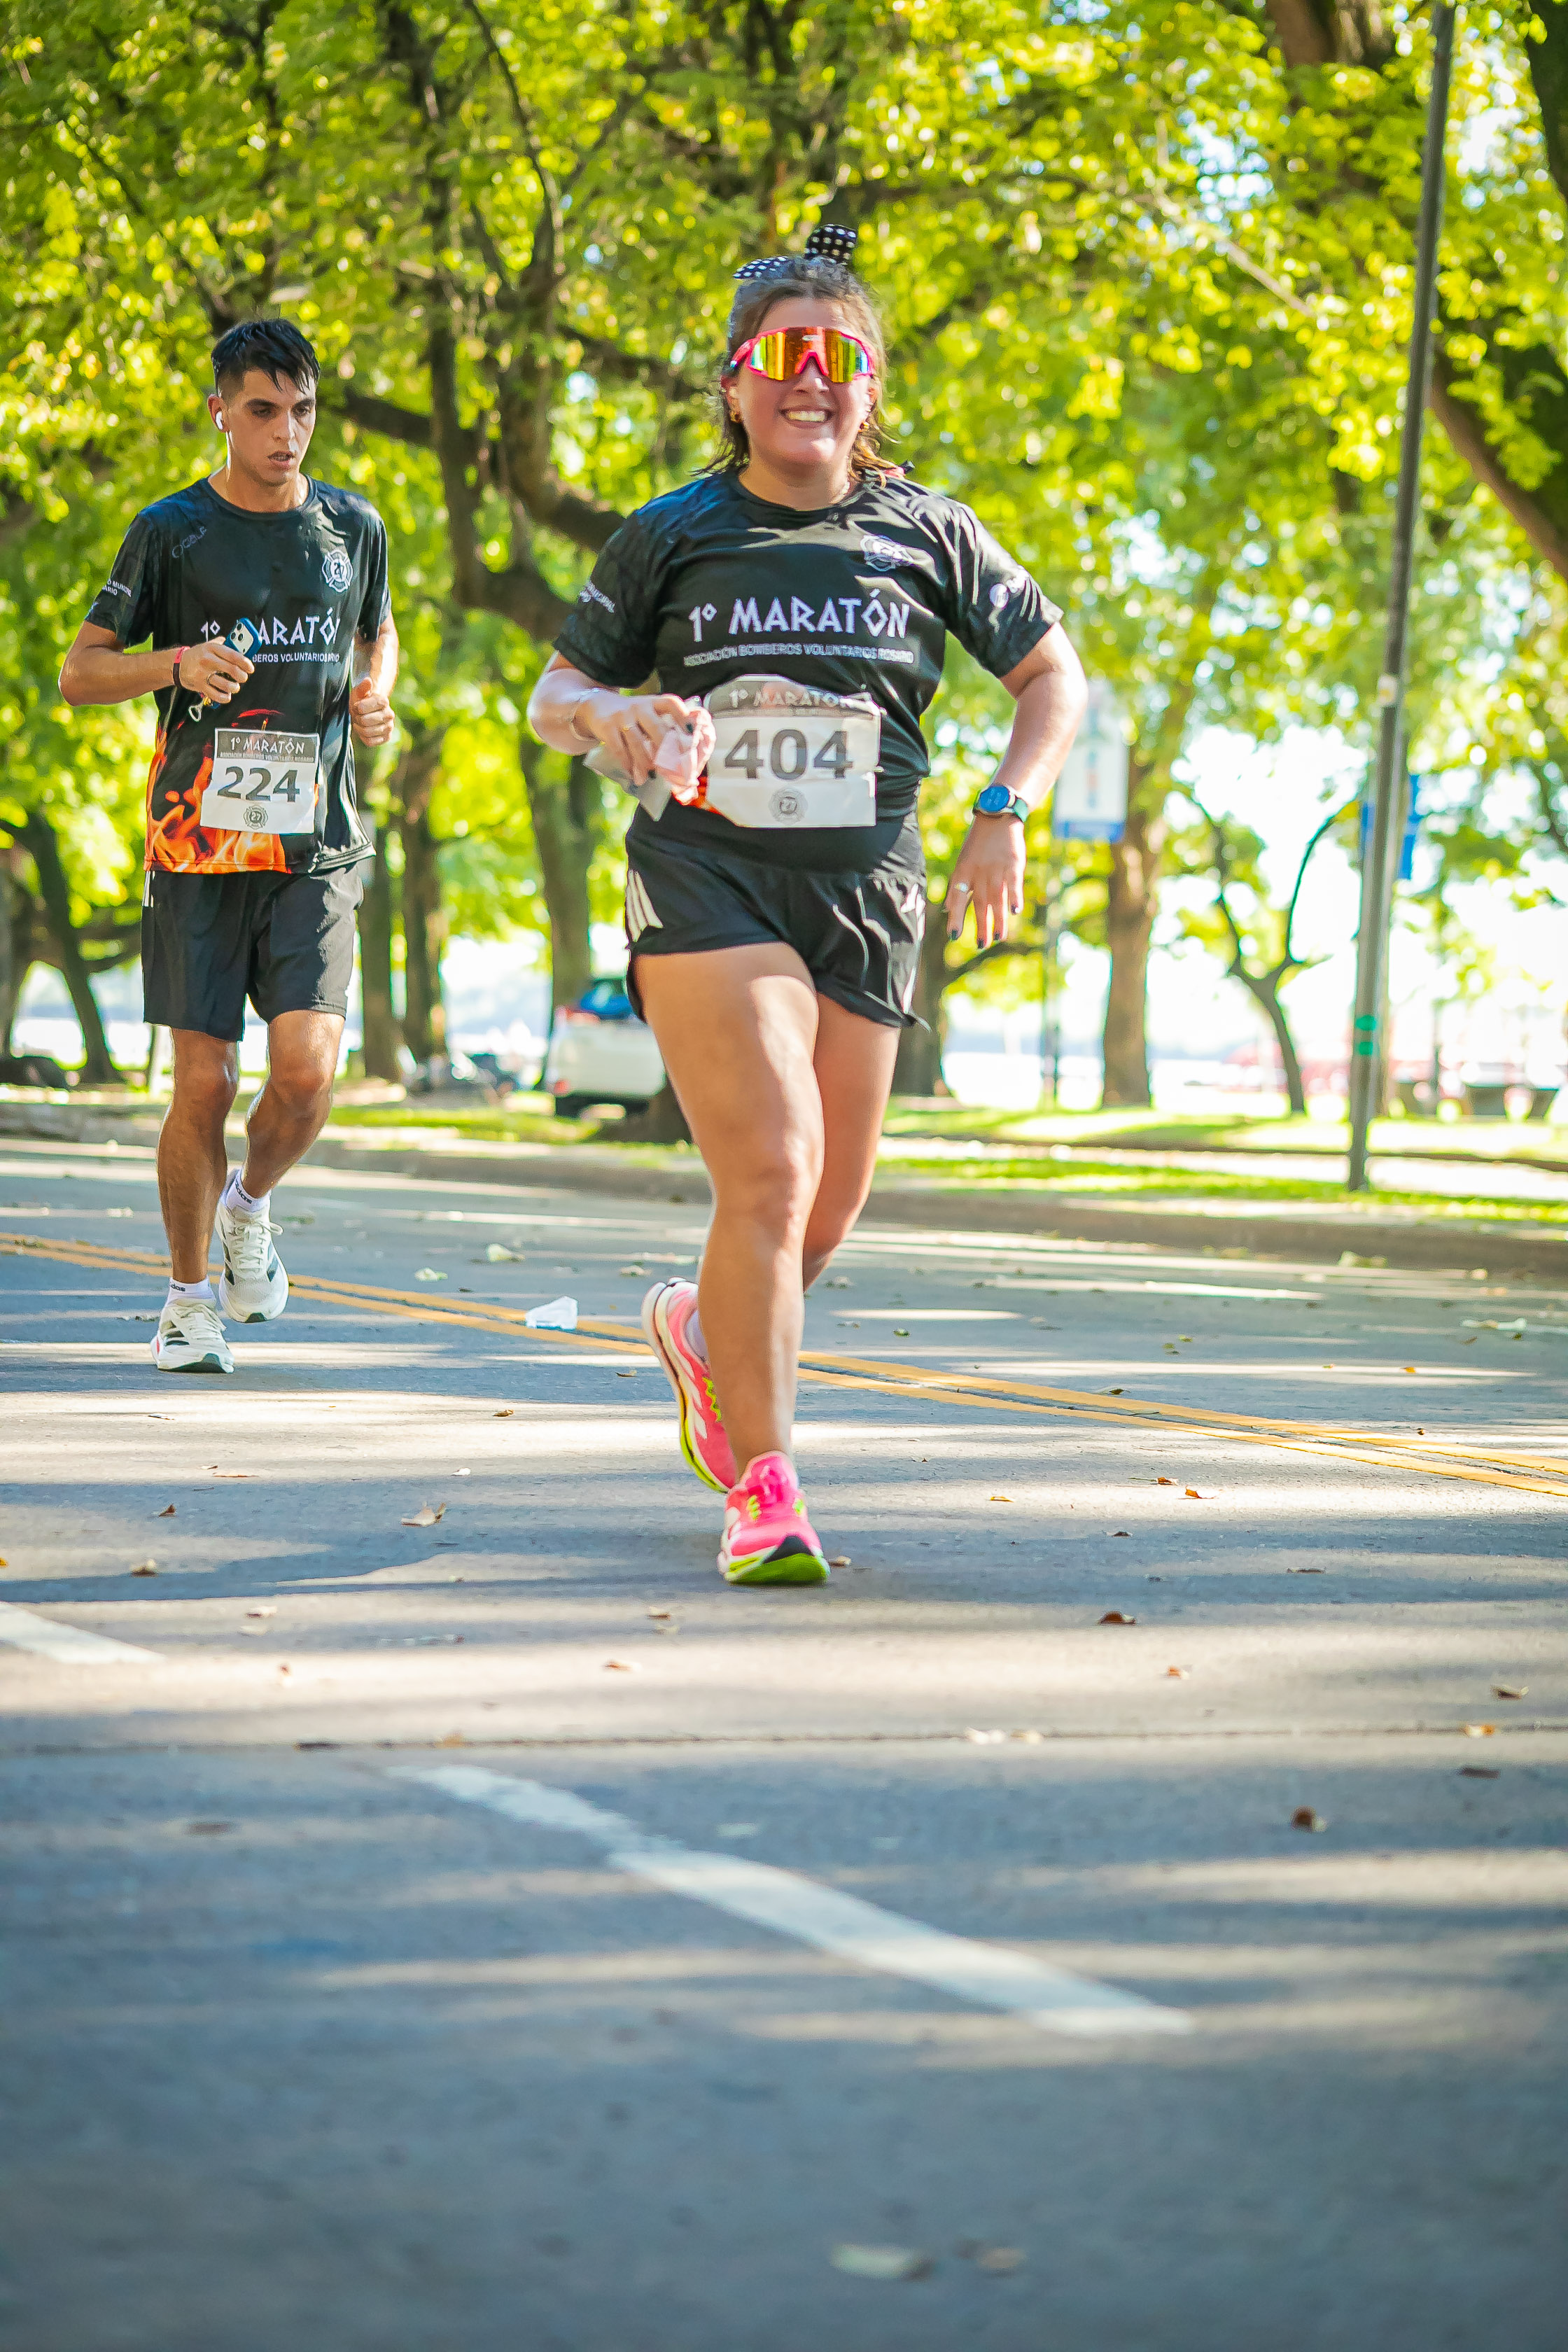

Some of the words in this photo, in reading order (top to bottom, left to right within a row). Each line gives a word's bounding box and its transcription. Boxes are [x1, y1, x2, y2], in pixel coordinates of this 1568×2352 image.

[258, 606, 341, 646] ARATÓ
[728, 589, 910, 638] MARATÓN
[252, 653, 279, 663] BEROS
[243, 737, 305, 755] MARATÓN
[724, 729, 854, 780] 404
[217, 766, 300, 803] 224
